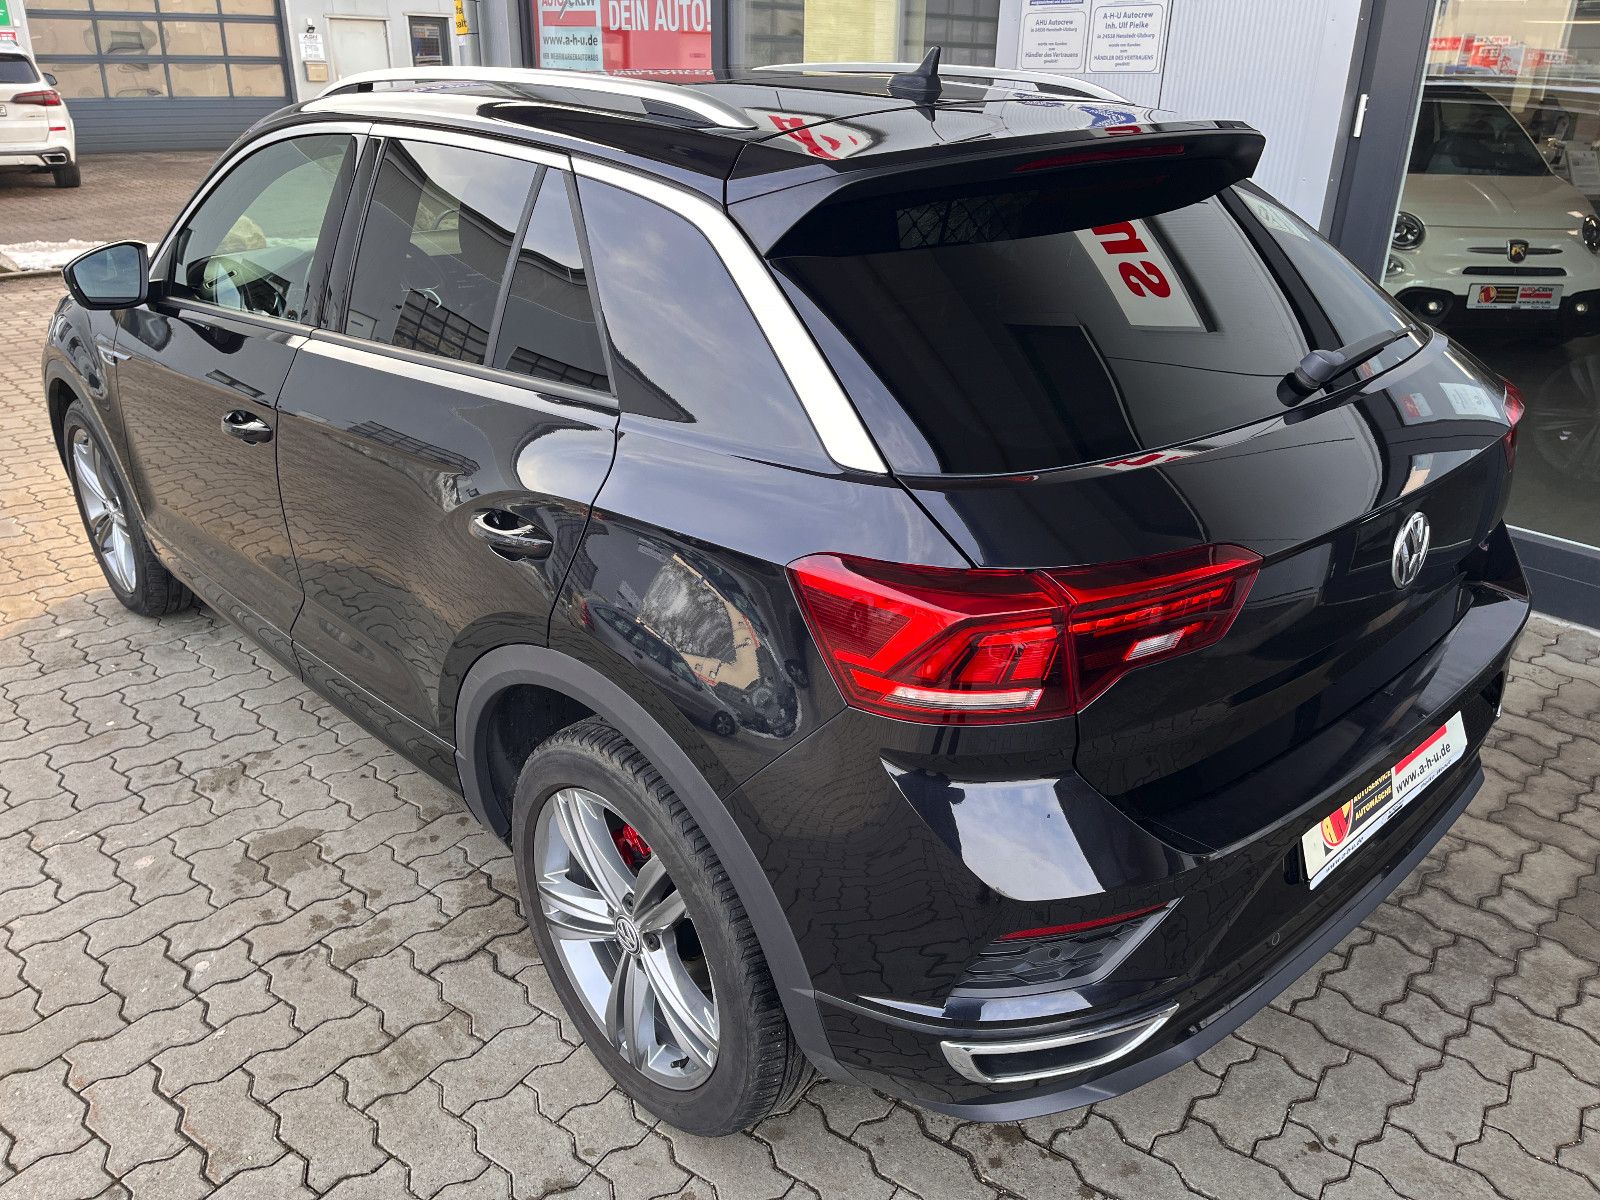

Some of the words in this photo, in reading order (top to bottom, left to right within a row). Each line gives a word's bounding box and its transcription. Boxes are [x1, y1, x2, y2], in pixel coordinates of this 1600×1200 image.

[609, 0, 649, 31] DEIN
[655, 0, 711, 32] AUTO!
[1118, 21, 1128, 29] Ulf
[543, 34, 598, 46] www.a-h-u.de
[1395, 743, 1451, 794] www.a-h-u.de
[1355, 785, 1393, 821] AUTOWÄSCHE
